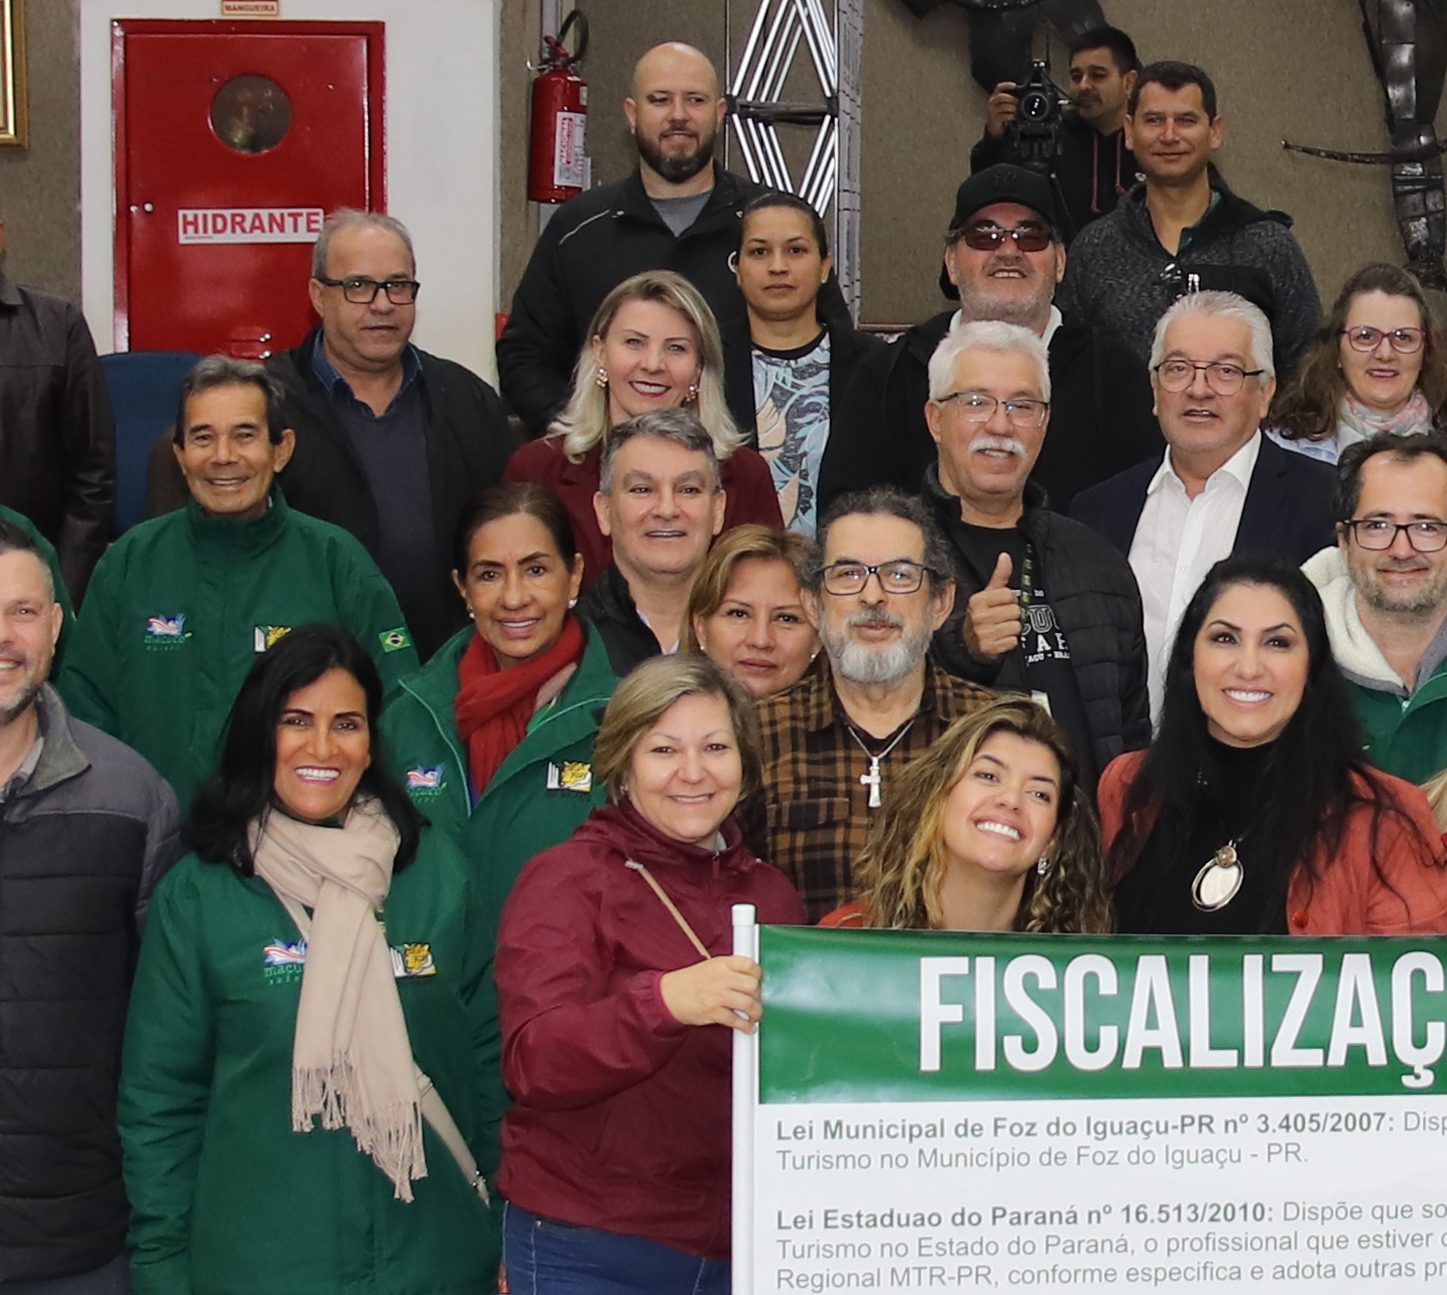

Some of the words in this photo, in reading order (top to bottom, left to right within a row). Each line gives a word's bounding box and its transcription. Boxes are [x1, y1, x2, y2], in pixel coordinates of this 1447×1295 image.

[182, 211, 322, 235] HIDRANTE
[264, 964, 303, 978] macu
[776, 1119, 814, 1141] Lei
[823, 1117, 945, 1145] Municipal
[953, 1117, 984, 1139] de
[993, 1116, 1038, 1138] Foz
[1045, 1116, 1078, 1137] do
[1085, 1113, 1216, 1142] Iguaçu-PR
[1223, 1113, 1249, 1135] nº
[1256, 1111, 1394, 1135] 3.405/2007:
[775, 1149, 872, 1171] Turismo
[880, 1153, 909, 1169] no
[917, 1146, 1031, 1172] Município
[1038, 1146, 1068, 1167] de
[1076, 1145, 1120, 1166] Foz
[1126, 1144, 1156, 1166] do
[1165, 1144, 1242, 1170] Iguaçu
[1267, 1142, 1308, 1163] PR.
[777, 1209, 814, 1231] Lei
[823, 1207, 943, 1230] Estaduao
[950, 1206, 983, 1228] do
[991, 1204, 1079, 1227] Paraná
[1087, 1203, 1113, 1225] nº
[1120, 1201, 1273, 1225] 16.513/2010:
[1283, 1201, 1364, 1227] Dispõe
[1370, 1204, 1414, 1225] que
[776, 1238, 872, 1260] Turismo
[880, 1242, 909, 1258] no
[917, 1235, 1000, 1258] Estado
[1006, 1235, 1037, 1256] do
[1044, 1233, 1135, 1260] Paraná,
[1143, 1237, 1159, 1254] o
[1166, 1230, 1298, 1258] profissional
[1306, 1232, 1350, 1256] que
[1357, 1228, 1434, 1250] estiver
[777, 1266, 881, 1294] Regional
[890, 1264, 999, 1291] MTR-PR,
[1007, 1263, 1118, 1285] conforme
[1125, 1260, 1242, 1287] especifica
[1250, 1264, 1264, 1281] e
[1271, 1259, 1337, 1280] adota
[1344, 1258, 1417, 1279] outras
